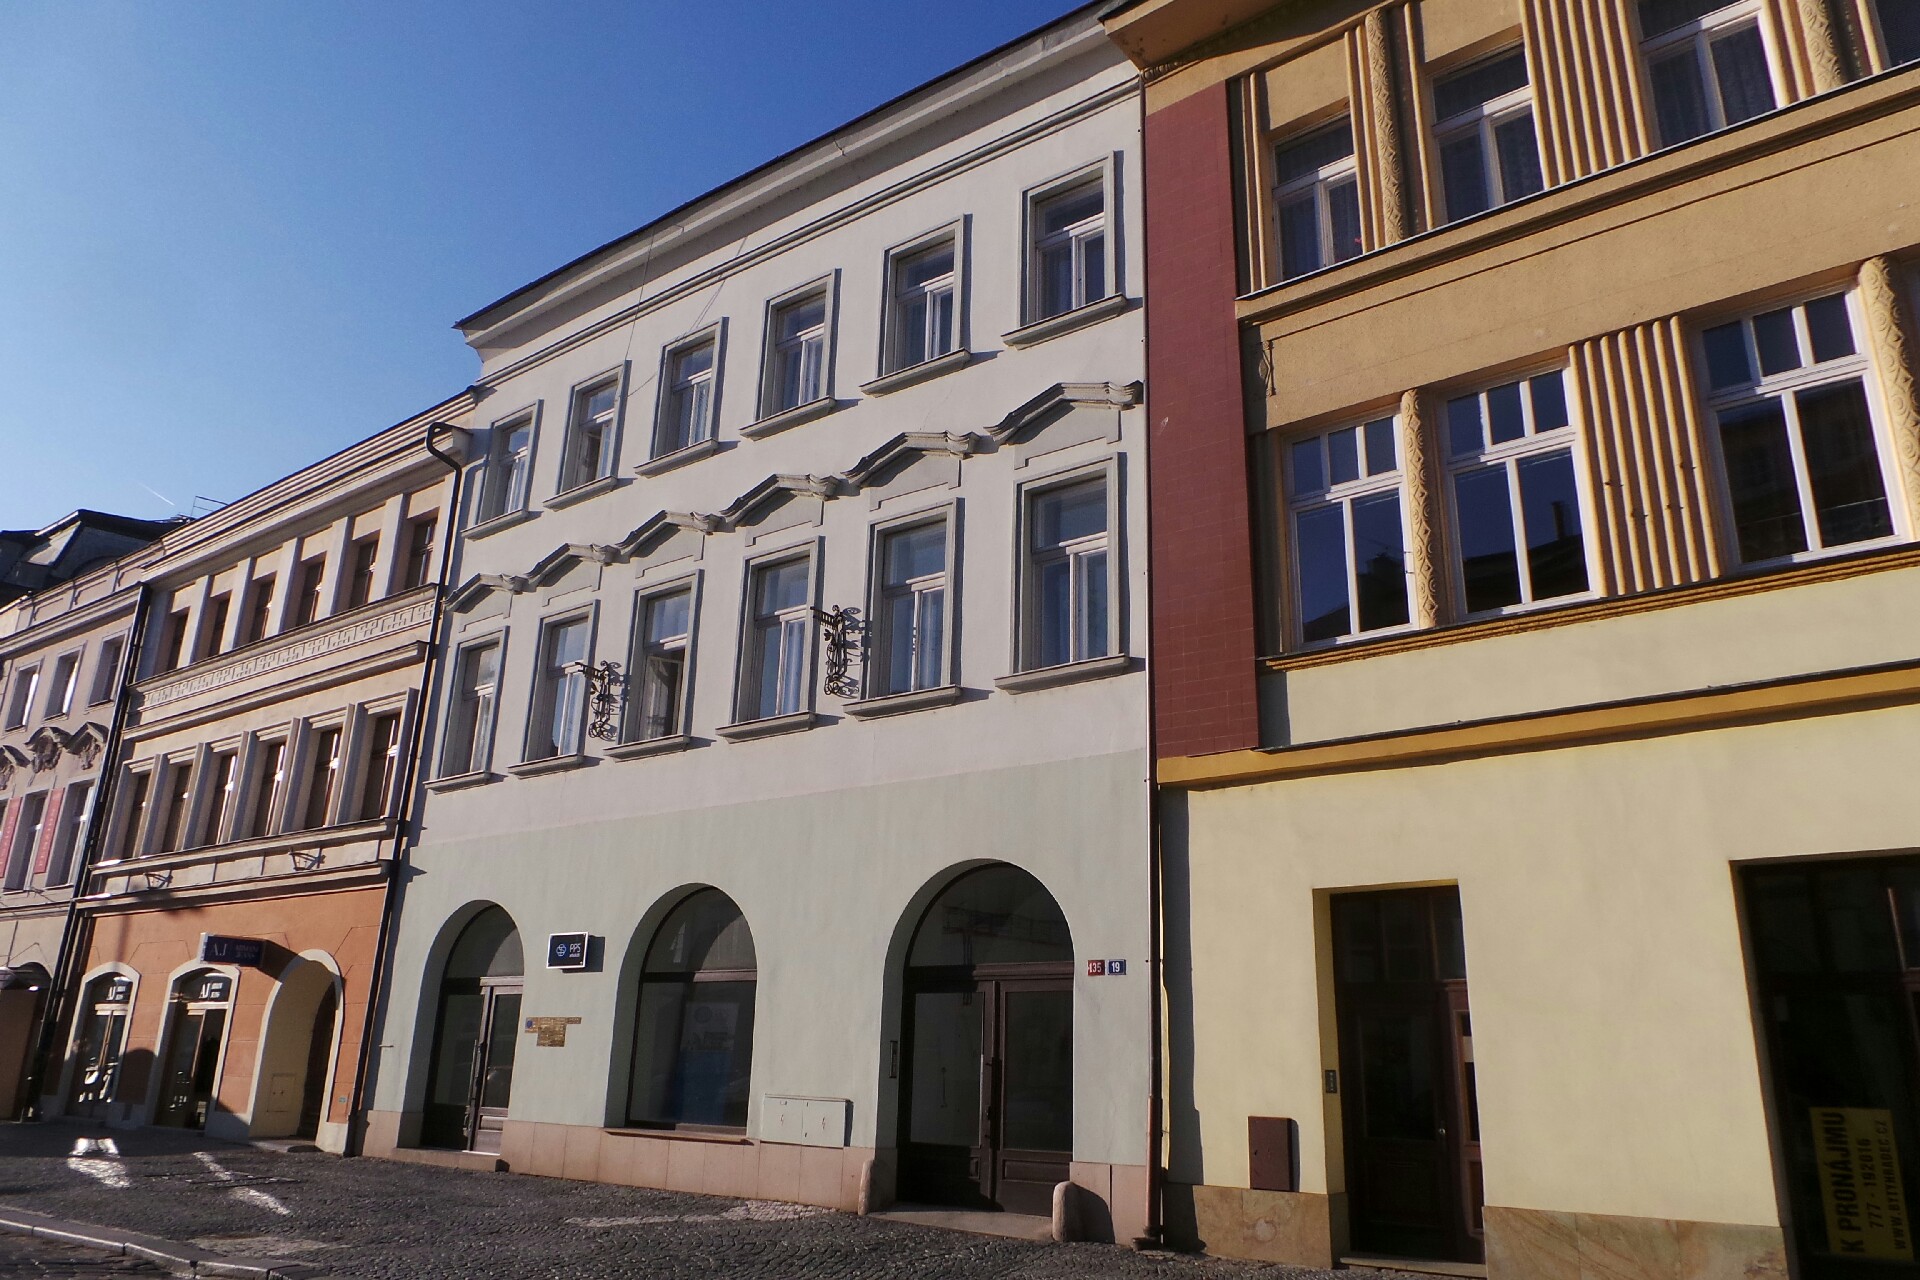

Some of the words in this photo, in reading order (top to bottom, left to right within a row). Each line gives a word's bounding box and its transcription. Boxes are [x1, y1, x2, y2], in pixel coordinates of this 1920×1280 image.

[1089, 962, 1102, 973] 135
[1111, 962, 1120, 973] 19
[1821, 1111, 1861, 1232] PRONÁJMU
[1856, 1138, 1878, 1187] 192016
[1866, 1201, 1884, 1229] 777
[1840, 1237, 1866, 1254] K
